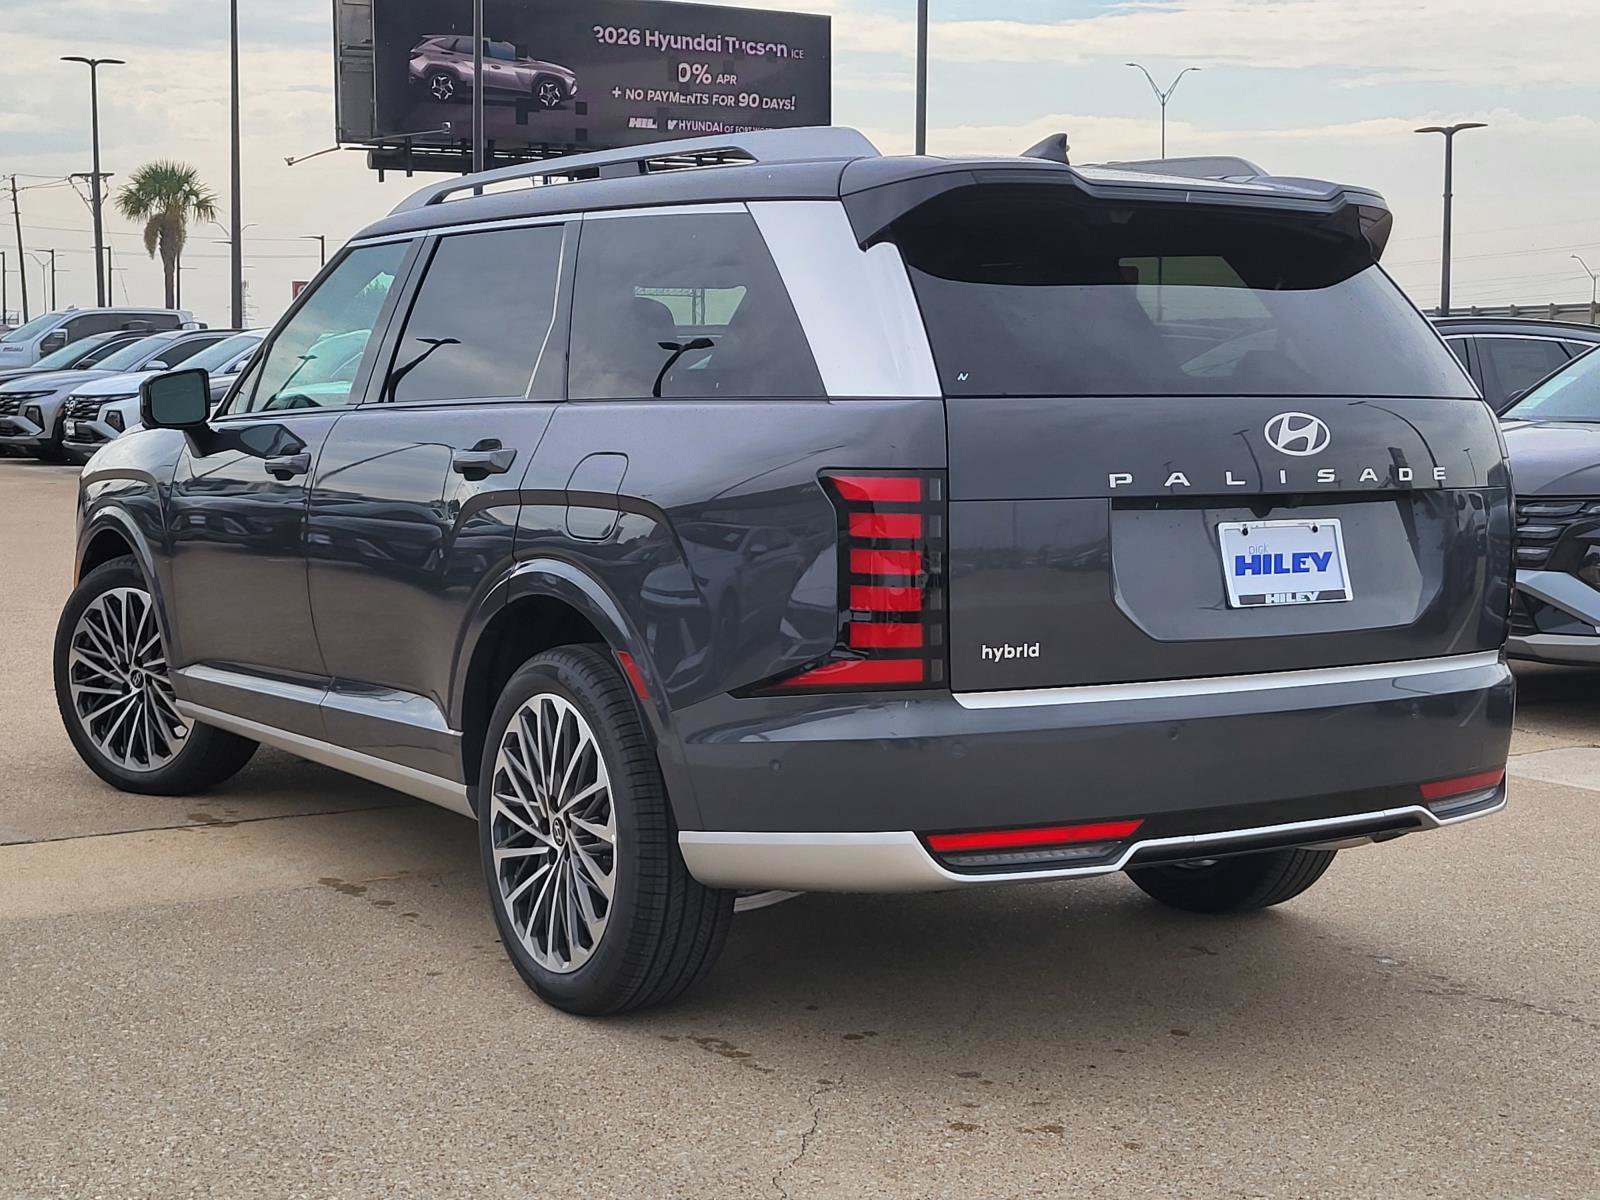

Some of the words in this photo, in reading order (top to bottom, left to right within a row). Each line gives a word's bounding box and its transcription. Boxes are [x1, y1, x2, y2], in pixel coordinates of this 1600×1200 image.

[593, 25, 641, 46] 2026
[645, 30, 721, 52] Hyundai
[791, 48, 804, 59] ICE
[678, 62, 712, 84] 0%
[716, 74, 737, 85] APR
[612, 86, 621, 98] +
[625, 88, 644, 100] NO
[647, 90, 709, 104] PAYMENTS
[712, 94, 735, 107] FOR
[738, 92, 760, 108] 90
[762, 95, 796, 111] DAYS!
[678, 119, 723, 133] HYUNDAI
[724, 125, 735, 133] OF
[1108, 465, 1447, 488] PALISADE
[1235, 551, 1333, 576] HILEY
[1265, 591, 1320, 604] HILEY
[981, 642, 1040, 663] hybrid
